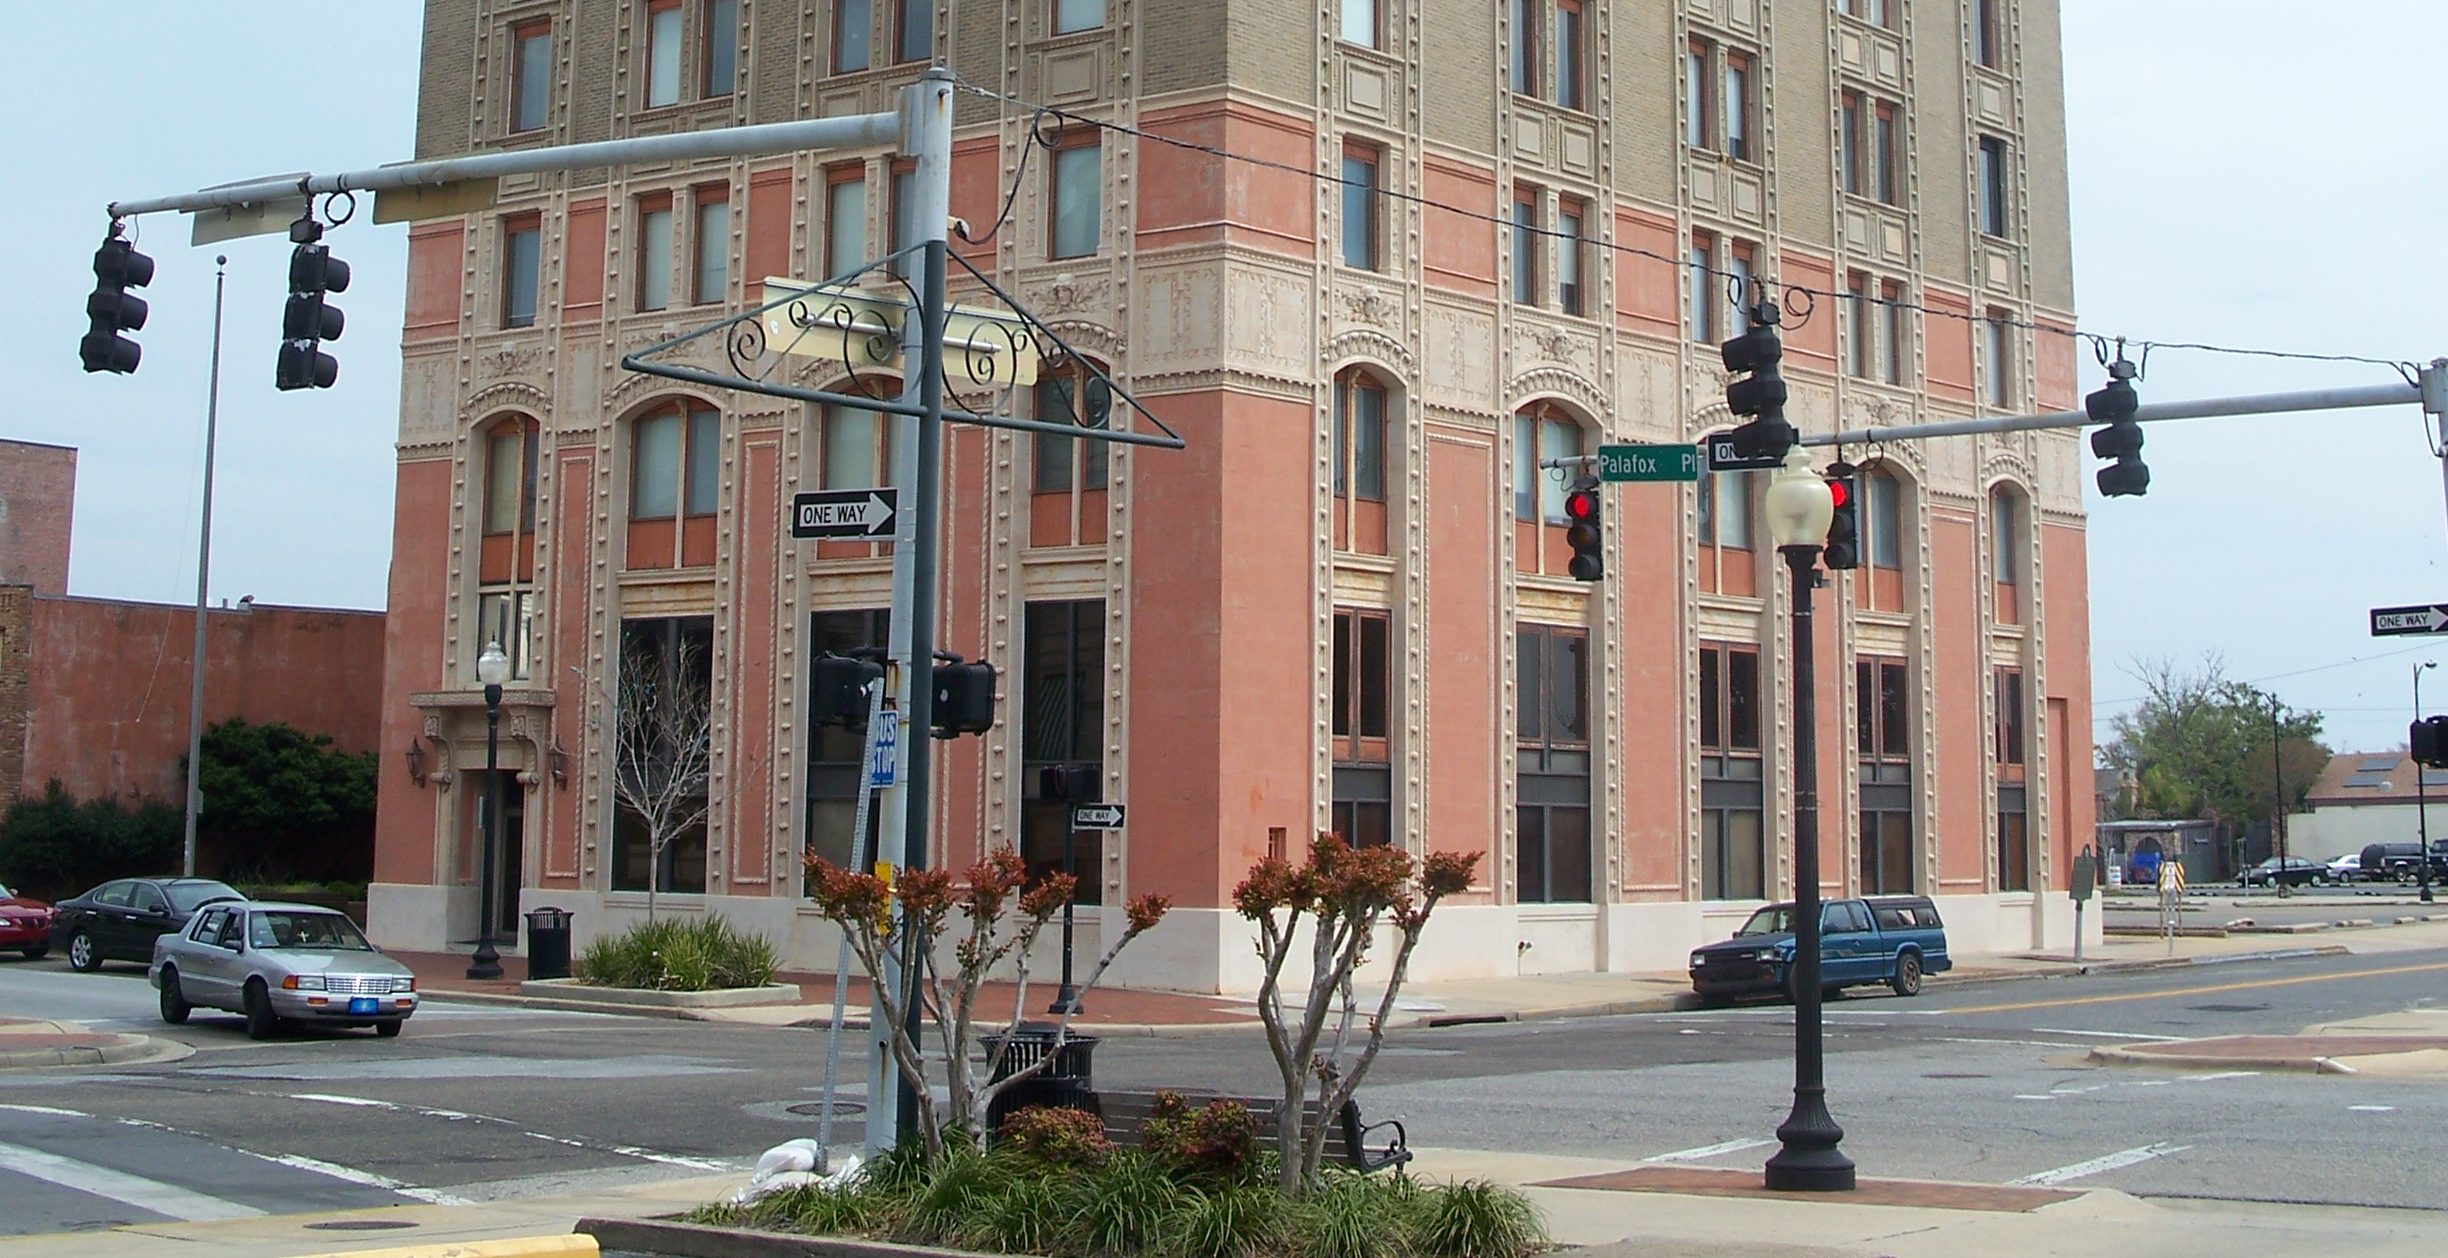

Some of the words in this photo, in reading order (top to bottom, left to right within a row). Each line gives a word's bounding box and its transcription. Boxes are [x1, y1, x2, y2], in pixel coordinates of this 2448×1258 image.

[1599, 454, 1657, 474] Palafox
[1681, 453, 1696, 473] Pl
[803, 506, 832, 524] ONE
[837, 504, 867, 523] WAY
[2379, 615, 2402, 628] ONE
[2405, 614, 2428, 626] WAY
[876, 714, 896, 743] US
[1095, 811, 1110, 821] WAY
